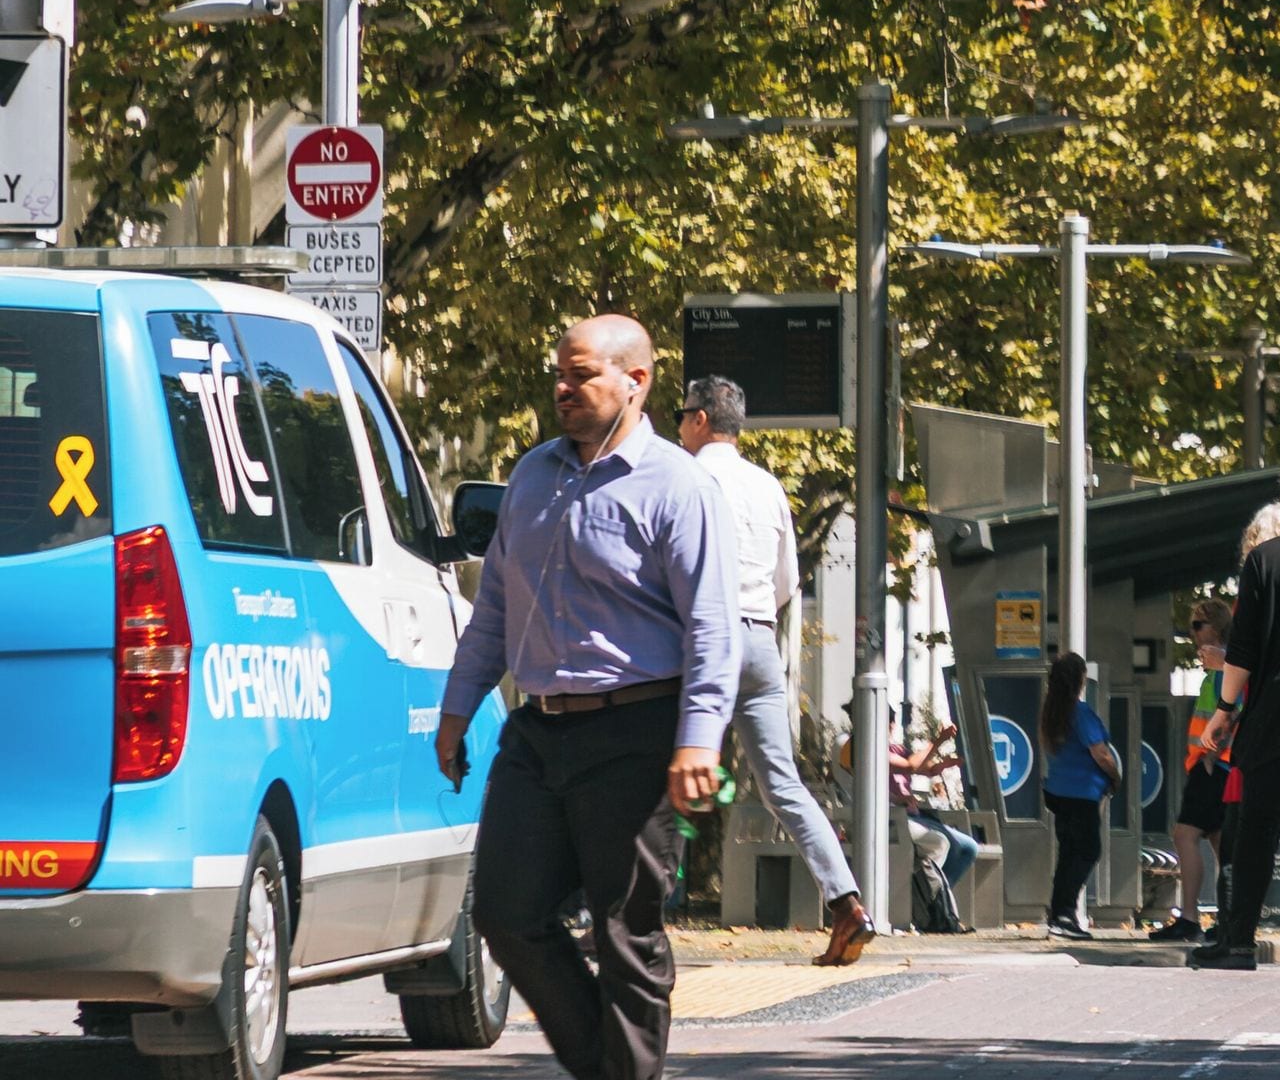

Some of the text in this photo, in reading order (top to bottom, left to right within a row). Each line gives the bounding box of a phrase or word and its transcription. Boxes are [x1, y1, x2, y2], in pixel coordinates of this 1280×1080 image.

[320, 141, 348, 162] NO
[303, 185, 368, 206] ENTRY
[306, 231, 361, 250] BUSES
[308, 255, 376, 274] CEPTED
[311, 296, 358, 312] TAXIS
[202, 642, 332, 722] OPERATIONS
